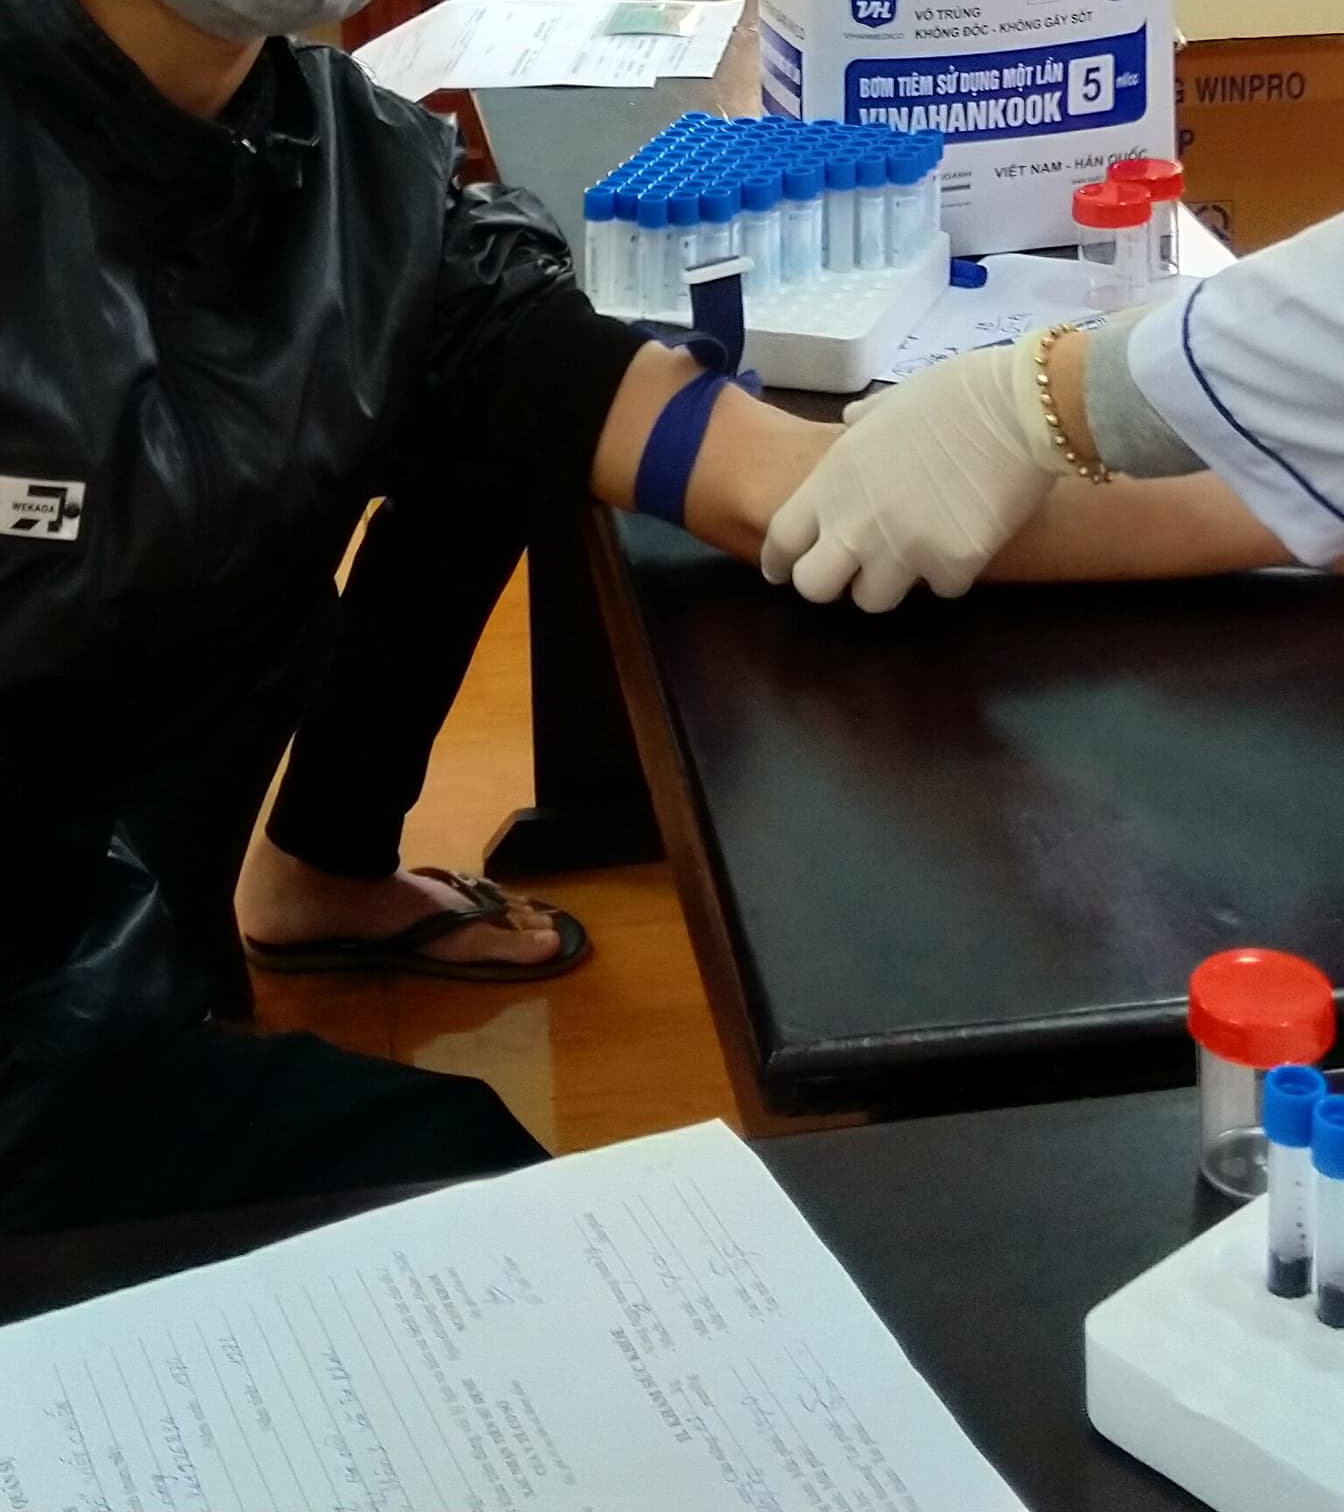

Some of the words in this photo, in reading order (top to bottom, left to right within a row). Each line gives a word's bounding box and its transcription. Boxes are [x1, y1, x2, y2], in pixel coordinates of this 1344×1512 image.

[856, 0, 892, 19] VH
[914, 7, 933, 21] VÔ
[935, 5, 981, 20] TRÙNG
[914, 27, 960, 39] KHÔNG
[999, 18, 1041, 33] KHÔNG
[859, 76, 895, 98] BƠM
[897, 72, 933, 97] TIÊM
[936, 65, 959, 95] SỬ
[959, 69, 1000, 96] DỤNG
[1002, 63, 1034, 92] MỘT
[1035, 56, 1064, 85] LẦN
[1082, 66, 1101, 102] 5
[1195, 71, 1306, 104] WINPRO
[859, 91, 1063, 135] VINAHANKOOK
[994, 163, 1026, 178] VIỆT
[1030, 162, 1062, 175] NAM
